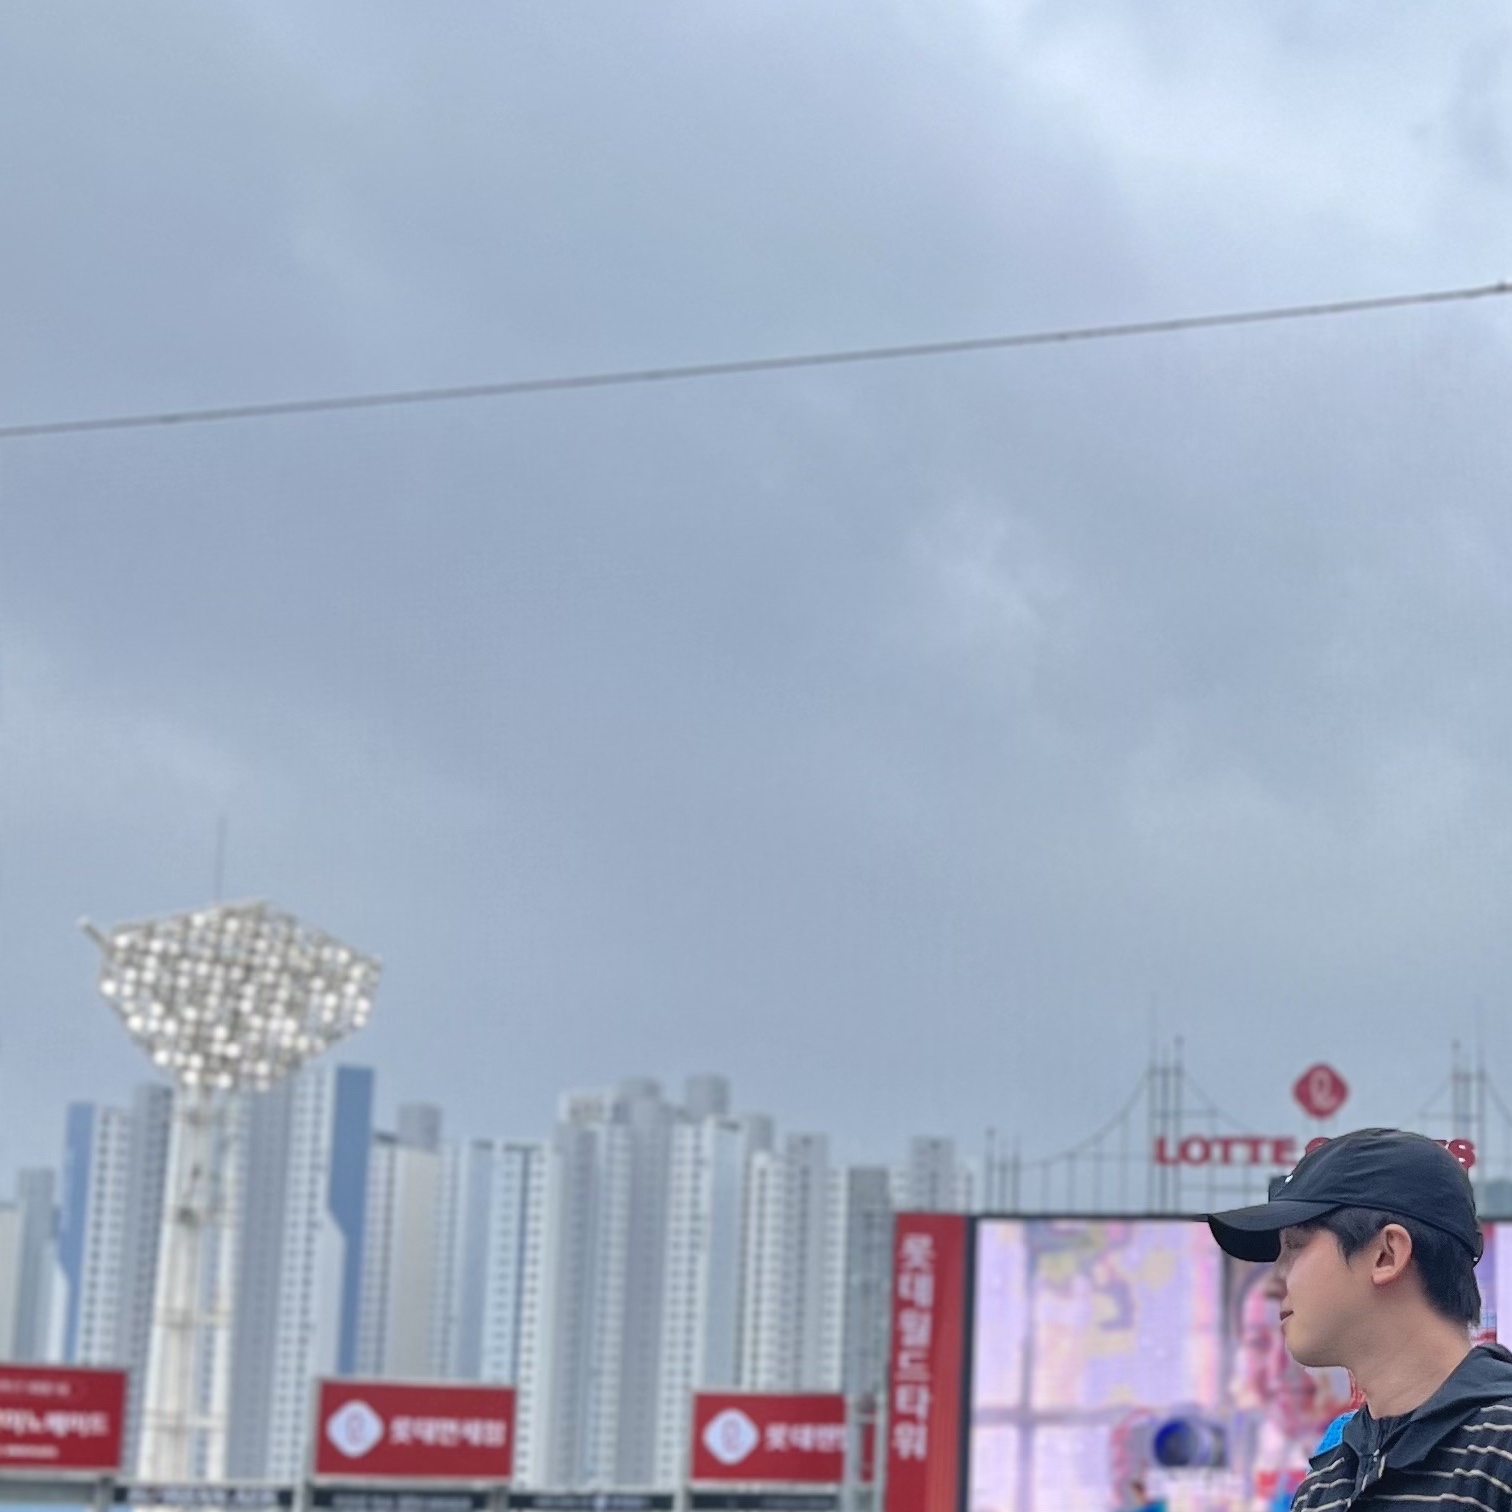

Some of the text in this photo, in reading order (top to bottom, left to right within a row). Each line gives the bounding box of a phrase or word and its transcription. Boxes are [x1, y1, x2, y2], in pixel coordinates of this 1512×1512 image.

[1155, 1136, 1298, 1166] LOTTE
[894, 1232, 936, 1461] 롯데월드타워
[390, 1415, 506, 1448] 롯데면세점
